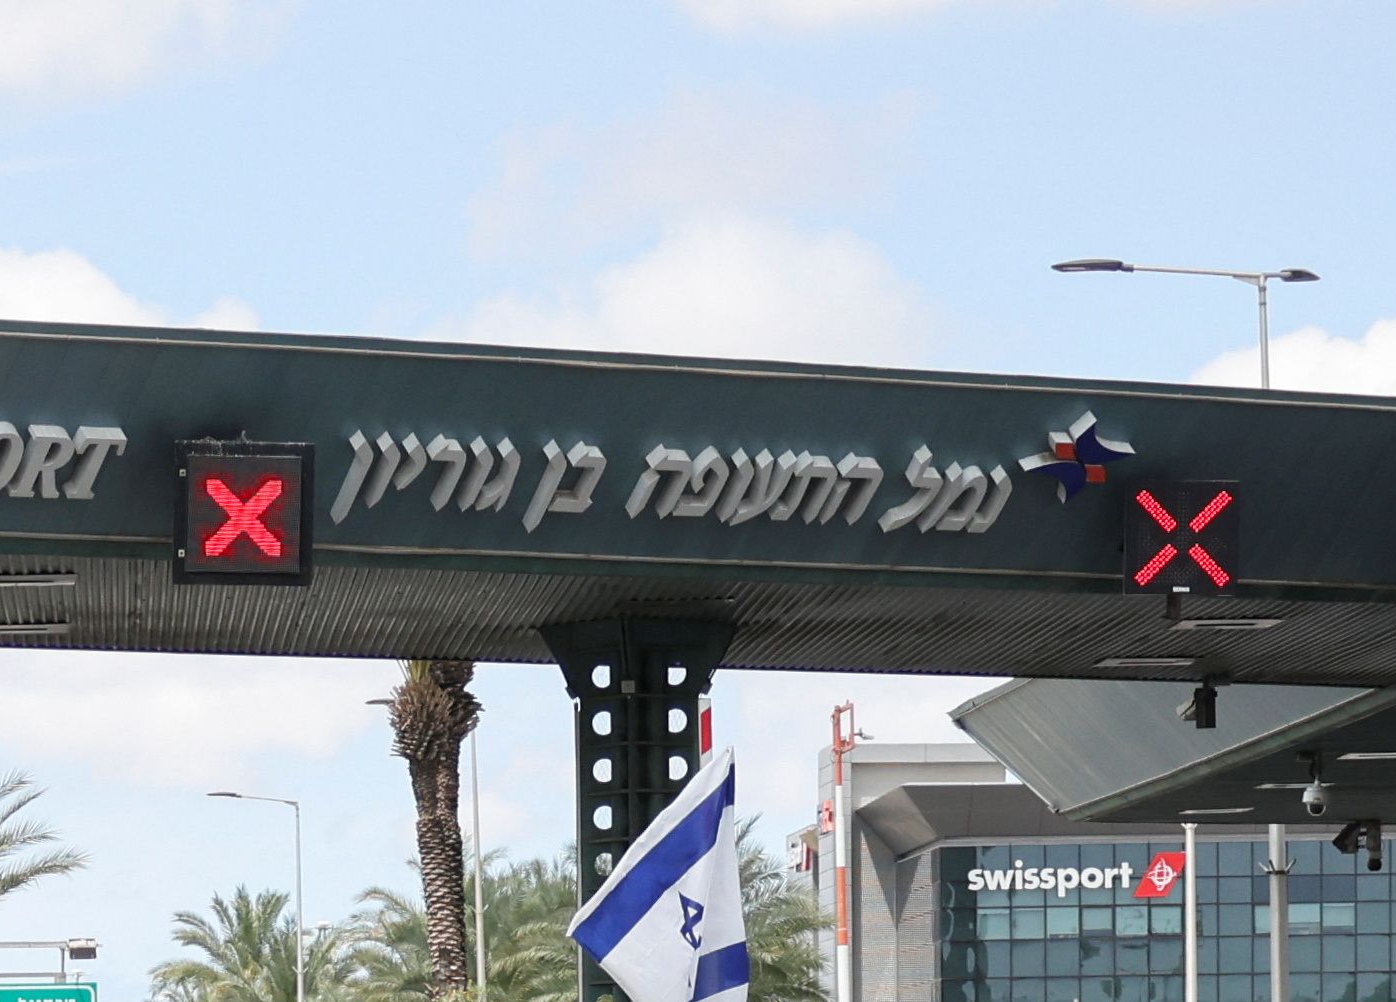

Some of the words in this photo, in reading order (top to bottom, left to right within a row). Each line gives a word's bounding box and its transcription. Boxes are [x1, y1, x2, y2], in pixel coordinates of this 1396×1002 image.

[330, 429, 521, 526] גוריון
[522, 439, 607, 534] בן
[624, 443, 884, 528] התעופה
[877, 443, 1013, 534] נמל
[967, 859, 1134, 897] swissport
